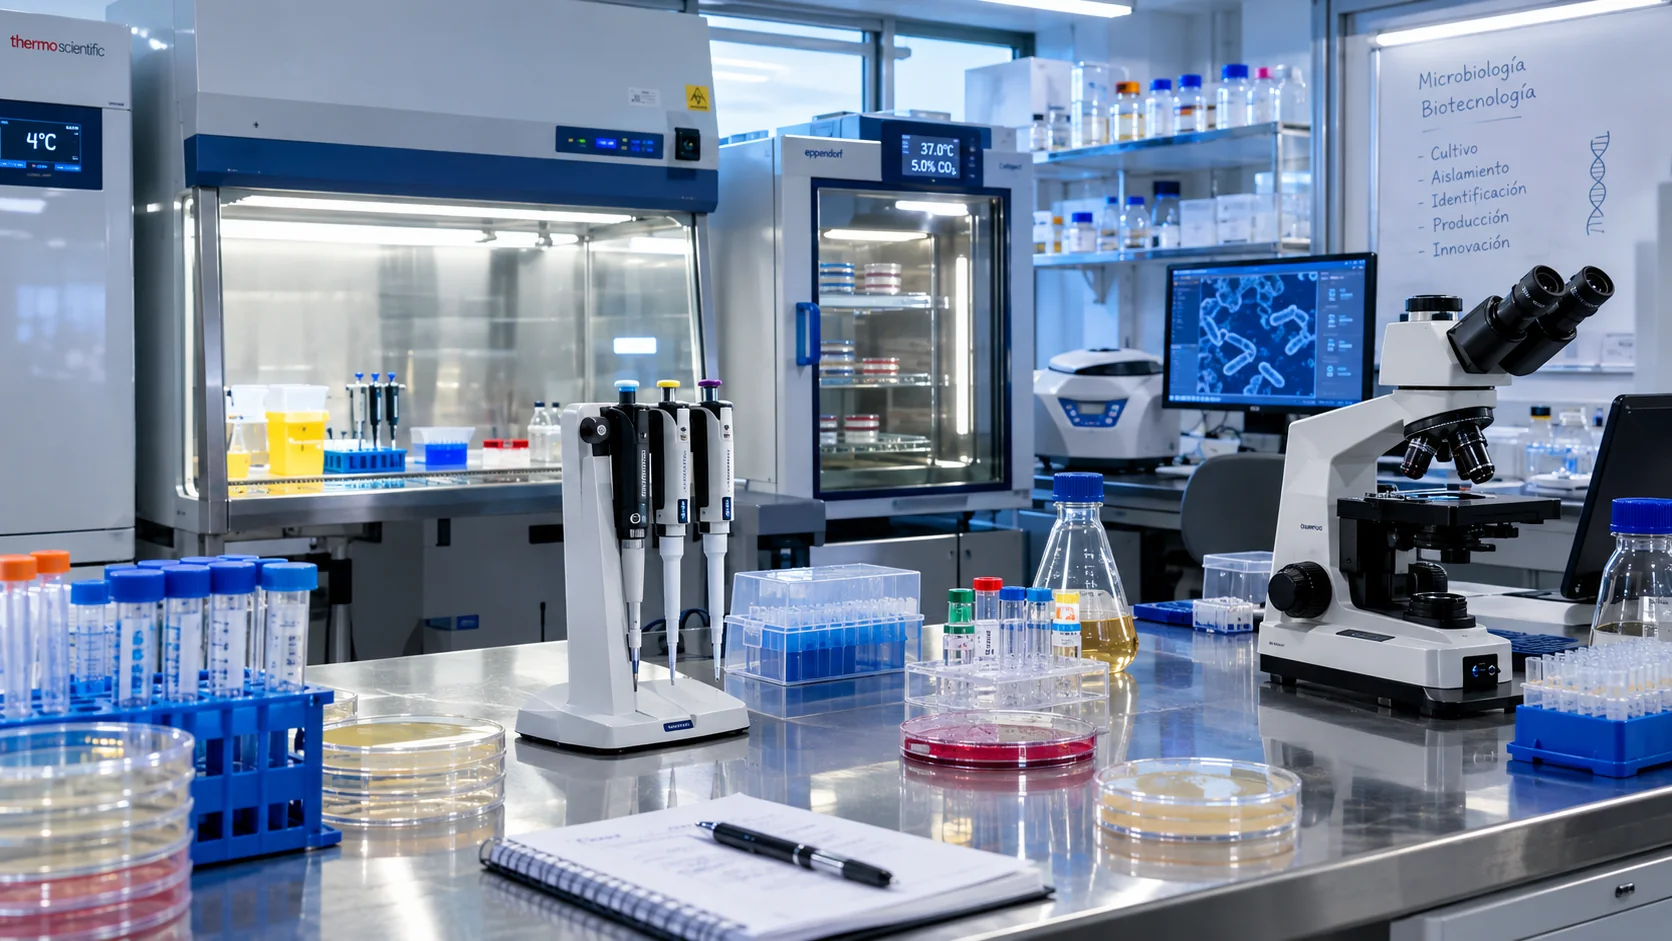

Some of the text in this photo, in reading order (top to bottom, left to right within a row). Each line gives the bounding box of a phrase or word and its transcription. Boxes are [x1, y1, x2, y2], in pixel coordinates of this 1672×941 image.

[1418, 55, 1526, 90] Microbiología
[1422, 82, 1537, 118] Biotecnología
[26, 132, 56, 151] 4°C
[804, 148, 843, 159] eppendorf
[920, 142, 955, 157] 37.0°C
[1431, 143, 1478, 161] Cultivo
[911, 159, 936, 173] 5.0%
[1431, 161, 1510, 185] Aislamiento
[1431, 180, 1527, 208] Identificación
[1433, 208, 1510, 233] Producción
[1432, 234, 1511, 258] Innovación
